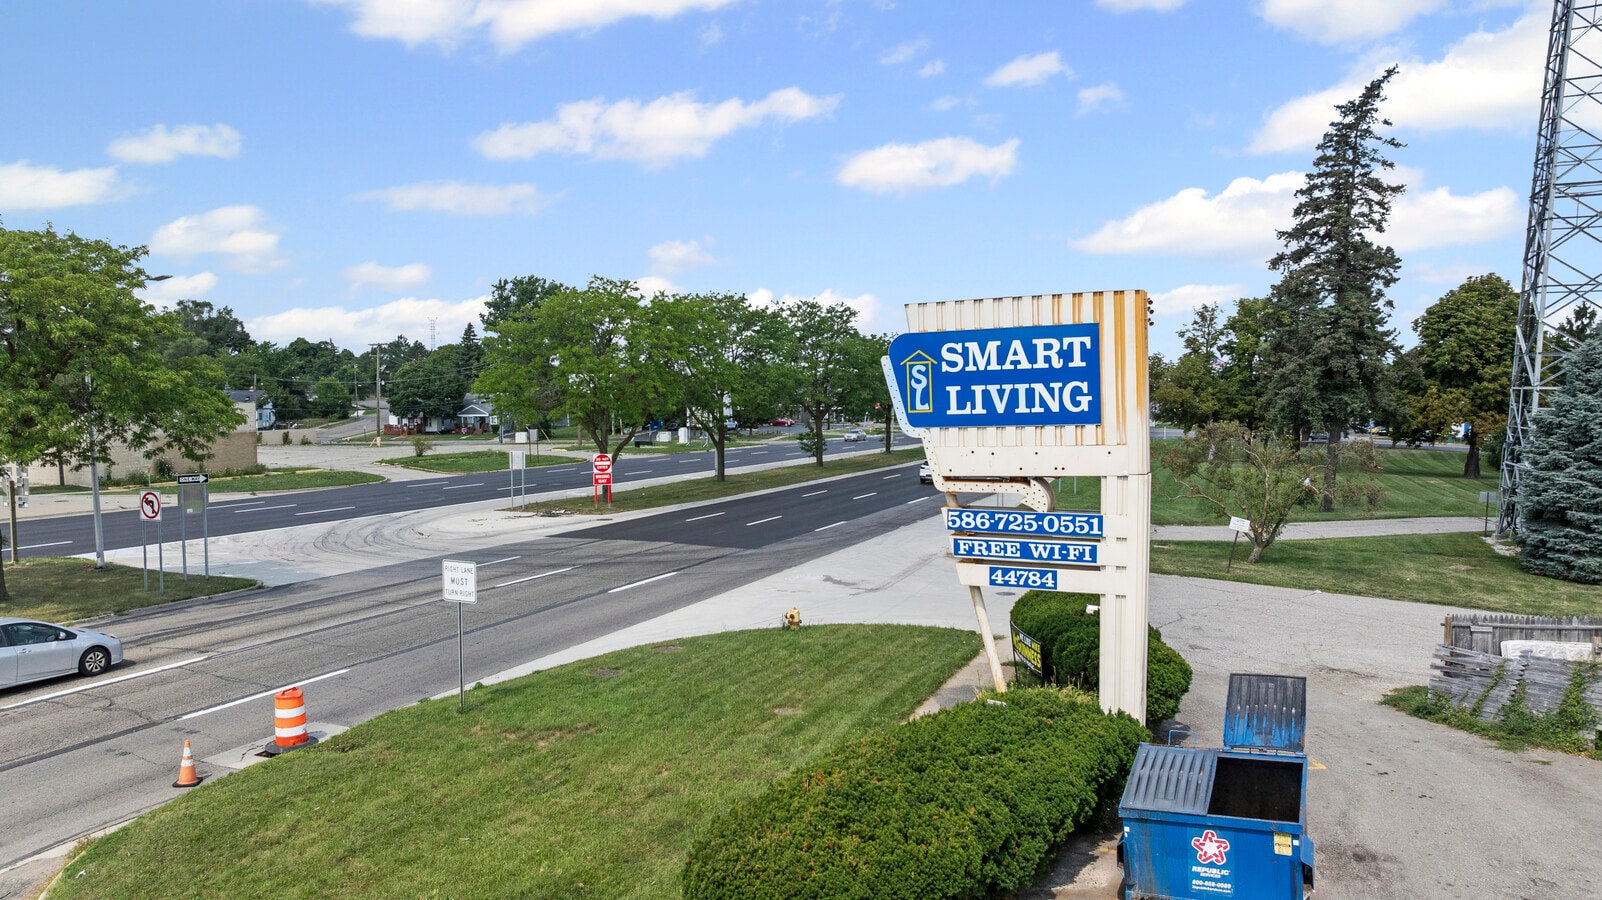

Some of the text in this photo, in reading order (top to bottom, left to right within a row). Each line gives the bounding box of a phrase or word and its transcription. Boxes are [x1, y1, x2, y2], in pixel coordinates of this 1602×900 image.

[941, 336, 1091, 373] SMART
[946, 381, 1092, 415] LIVING
[947, 511, 1102, 534] 586-725-0551
[957, 540, 1093, 561] FREE WI-FI
[445, 565, 474, 575] RIGHT LANE
[991, 569, 1055, 588] 44784
[450, 577, 468, 586] MUST
[445, 588, 475, 598] TURN RIGHT
[1192, 866, 1229, 876] REPUBLIC
